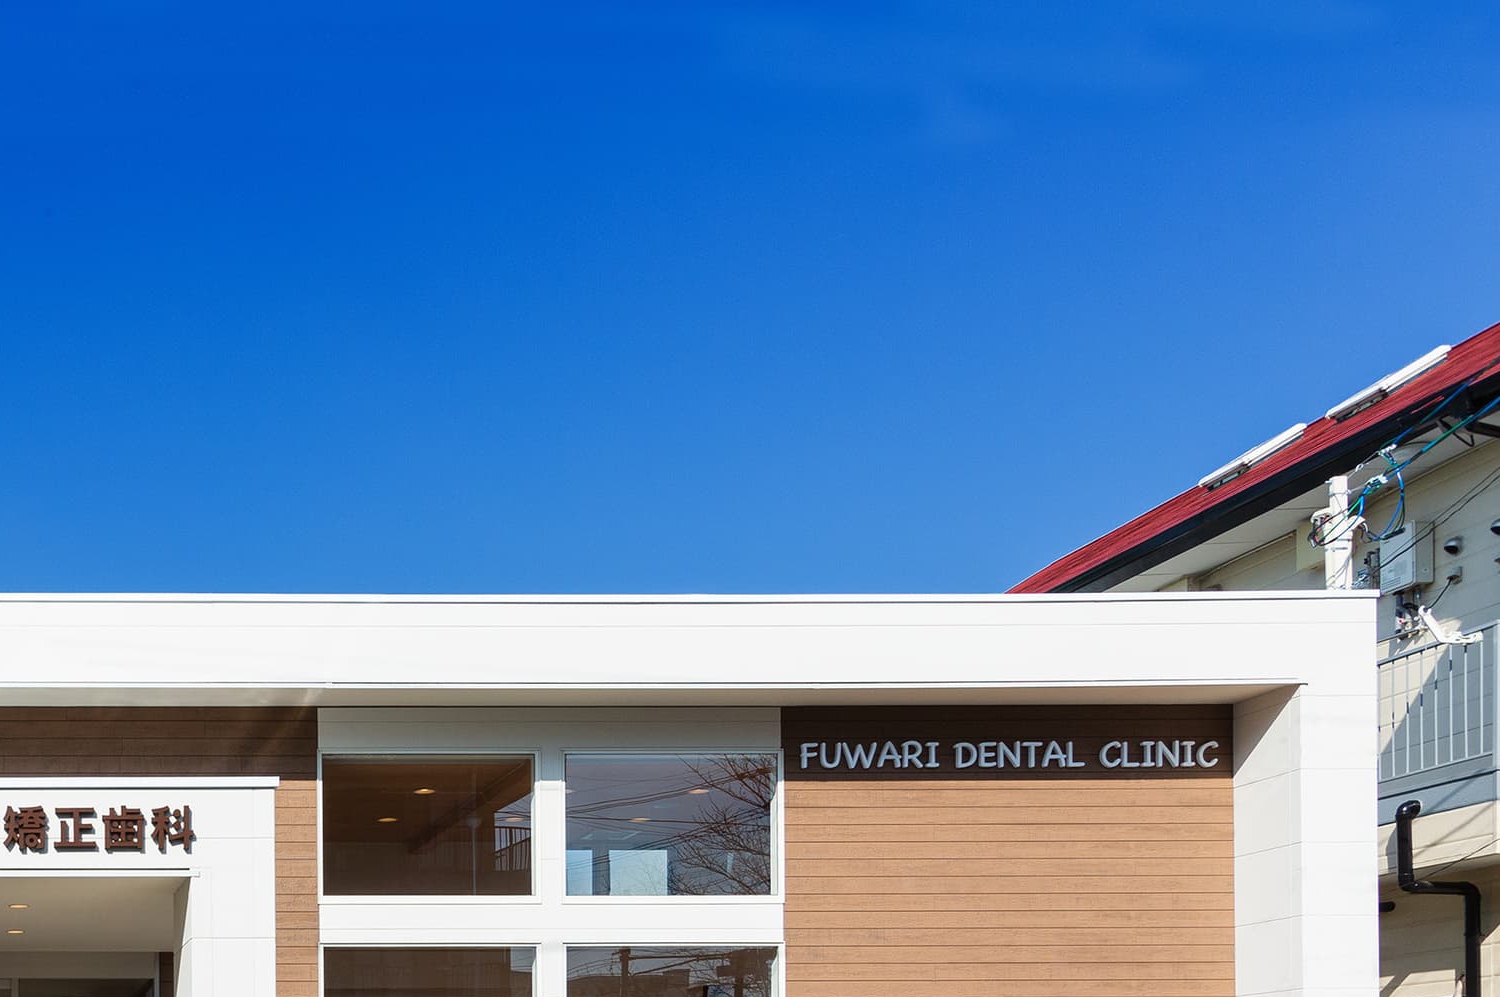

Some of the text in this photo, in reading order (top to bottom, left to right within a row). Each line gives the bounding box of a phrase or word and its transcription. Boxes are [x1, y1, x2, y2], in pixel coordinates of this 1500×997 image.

[800, 740, 1219, 769] FUWARI DENTAL CLINIC
